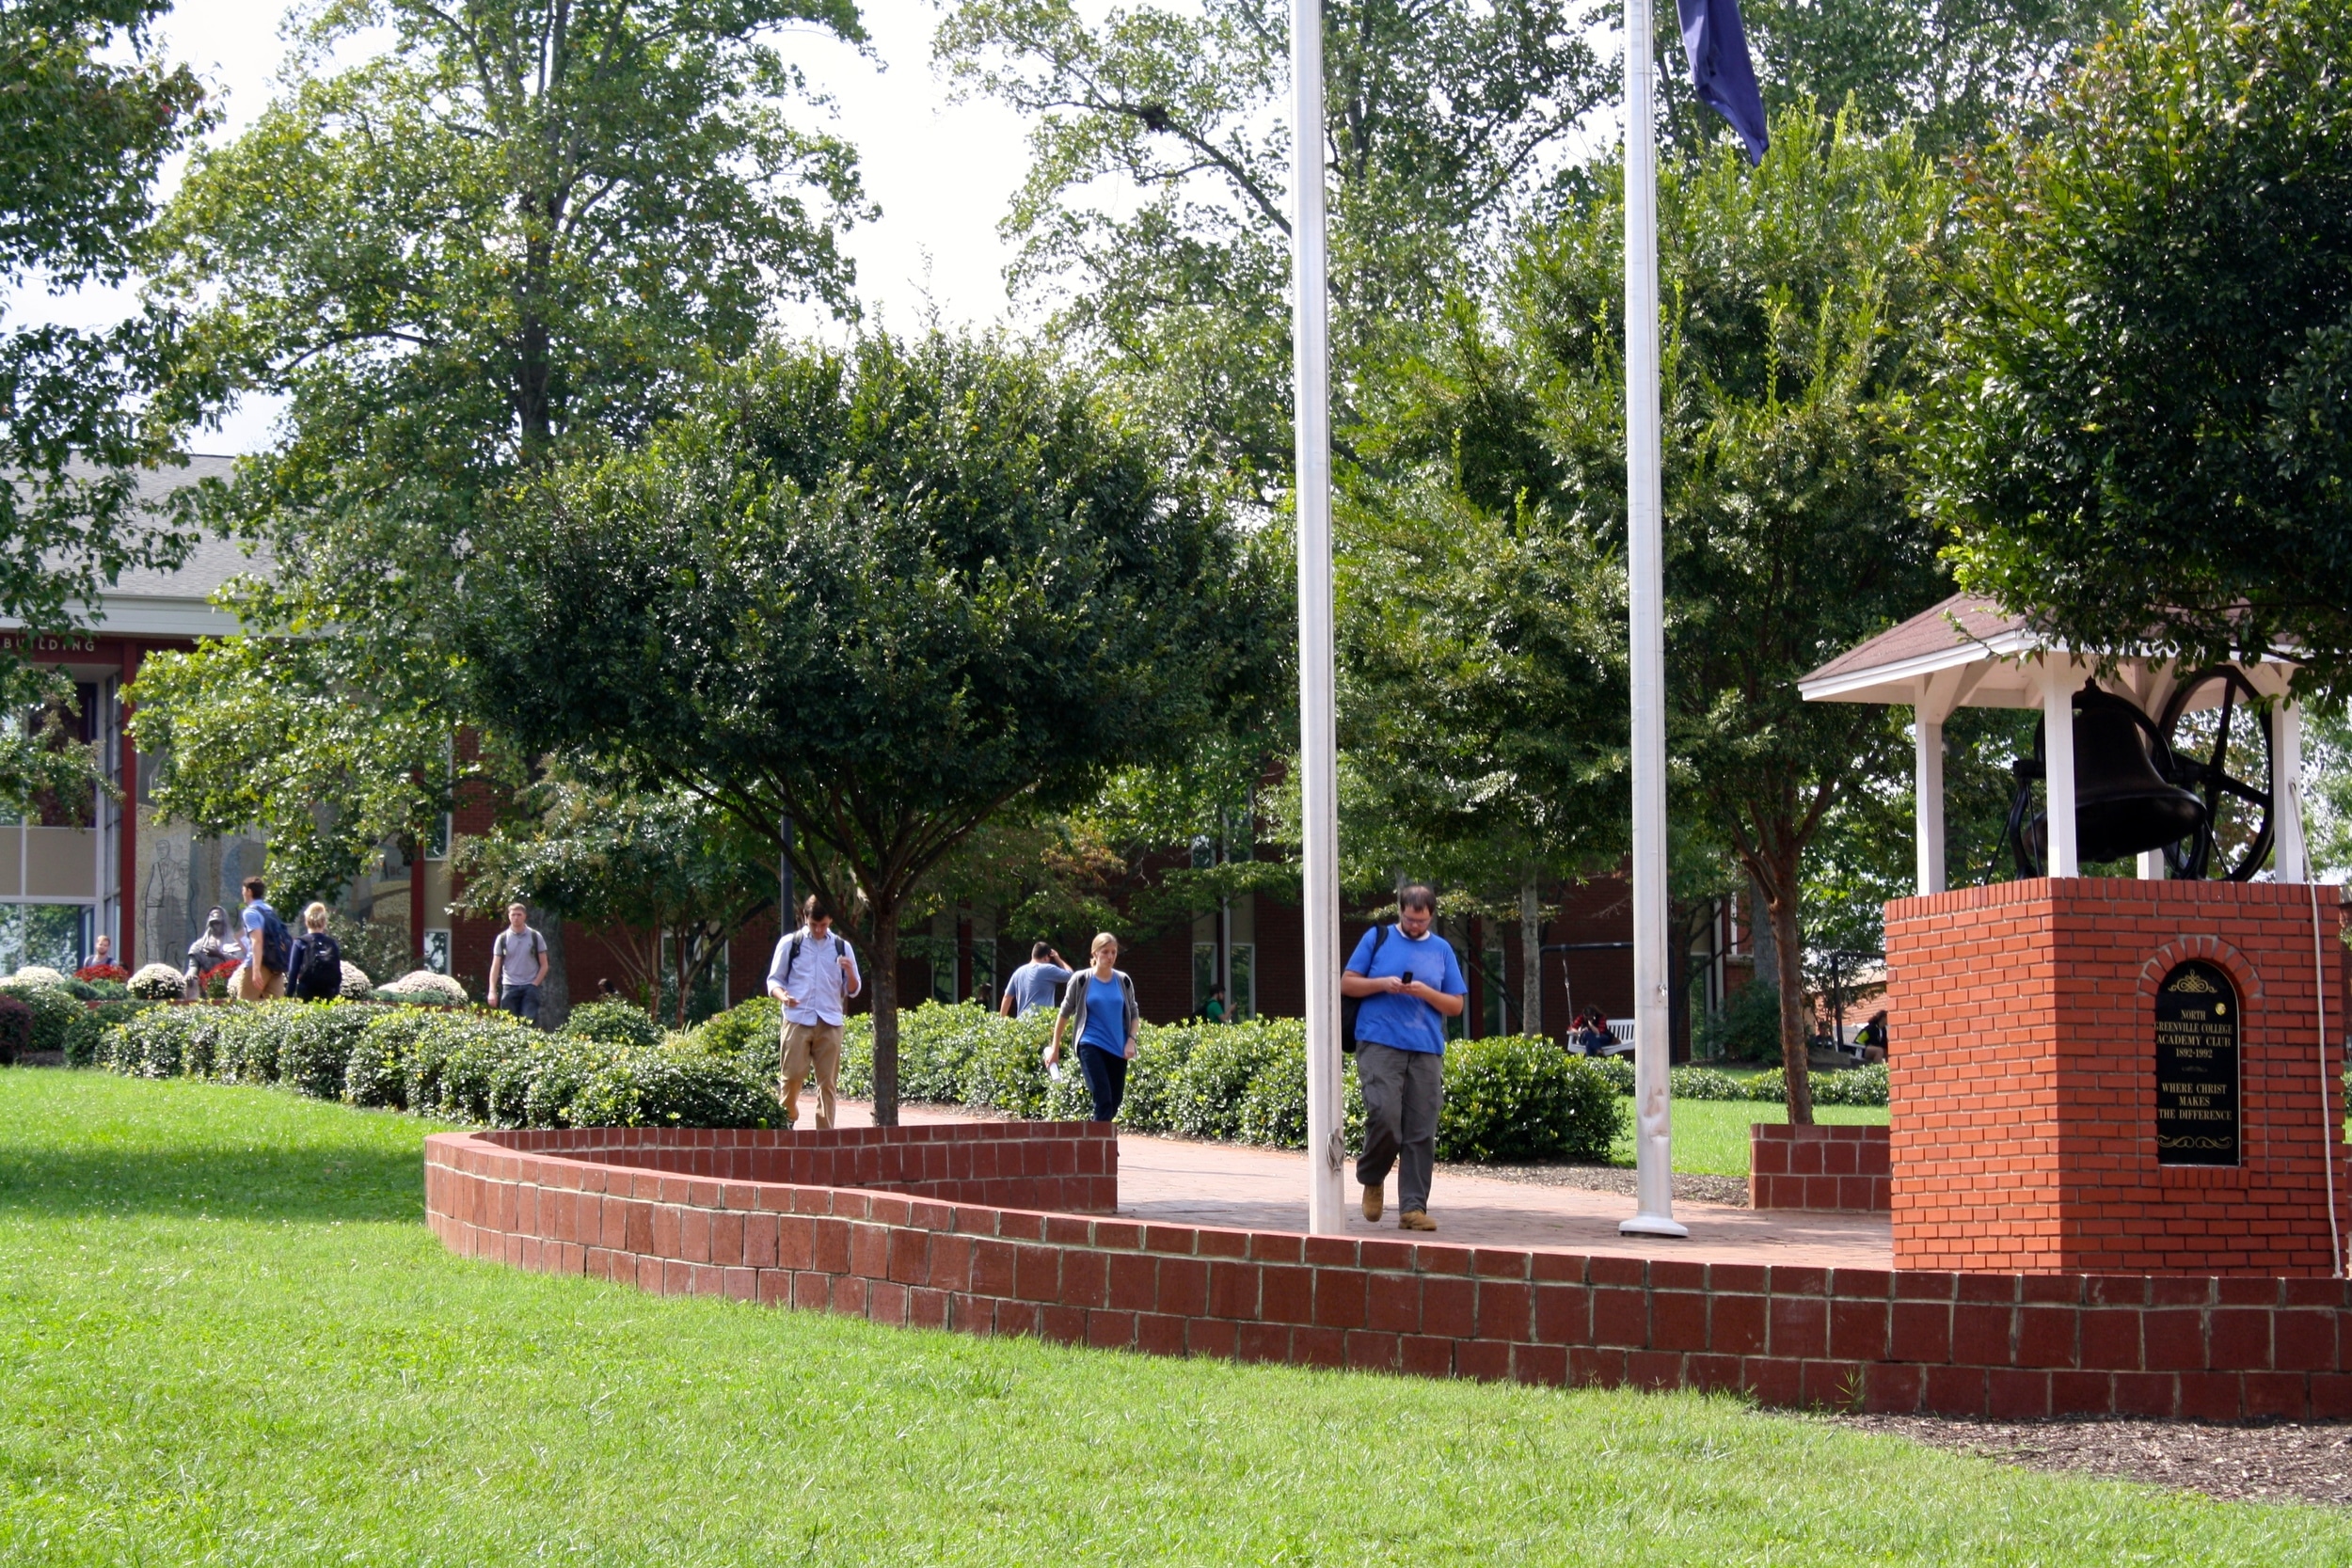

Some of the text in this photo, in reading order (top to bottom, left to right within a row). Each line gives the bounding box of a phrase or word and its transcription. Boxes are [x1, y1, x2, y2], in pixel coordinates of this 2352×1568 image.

[2181, 1009, 2206, 1021] NORTH
[2154, 1022, 2233, 1034] GREENVILLE COLLEGE
[2156, 1035, 2232, 1047] ACADEMY CLUB
[2176, 1048, 2213, 1058] 1892-1992
[2161, 1083, 2228, 1095] WHERE CHRIST
[2179, 1096, 2211, 1106] MAKES
[2158, 1109, 2233, 1120] THE DIFFERENCE
